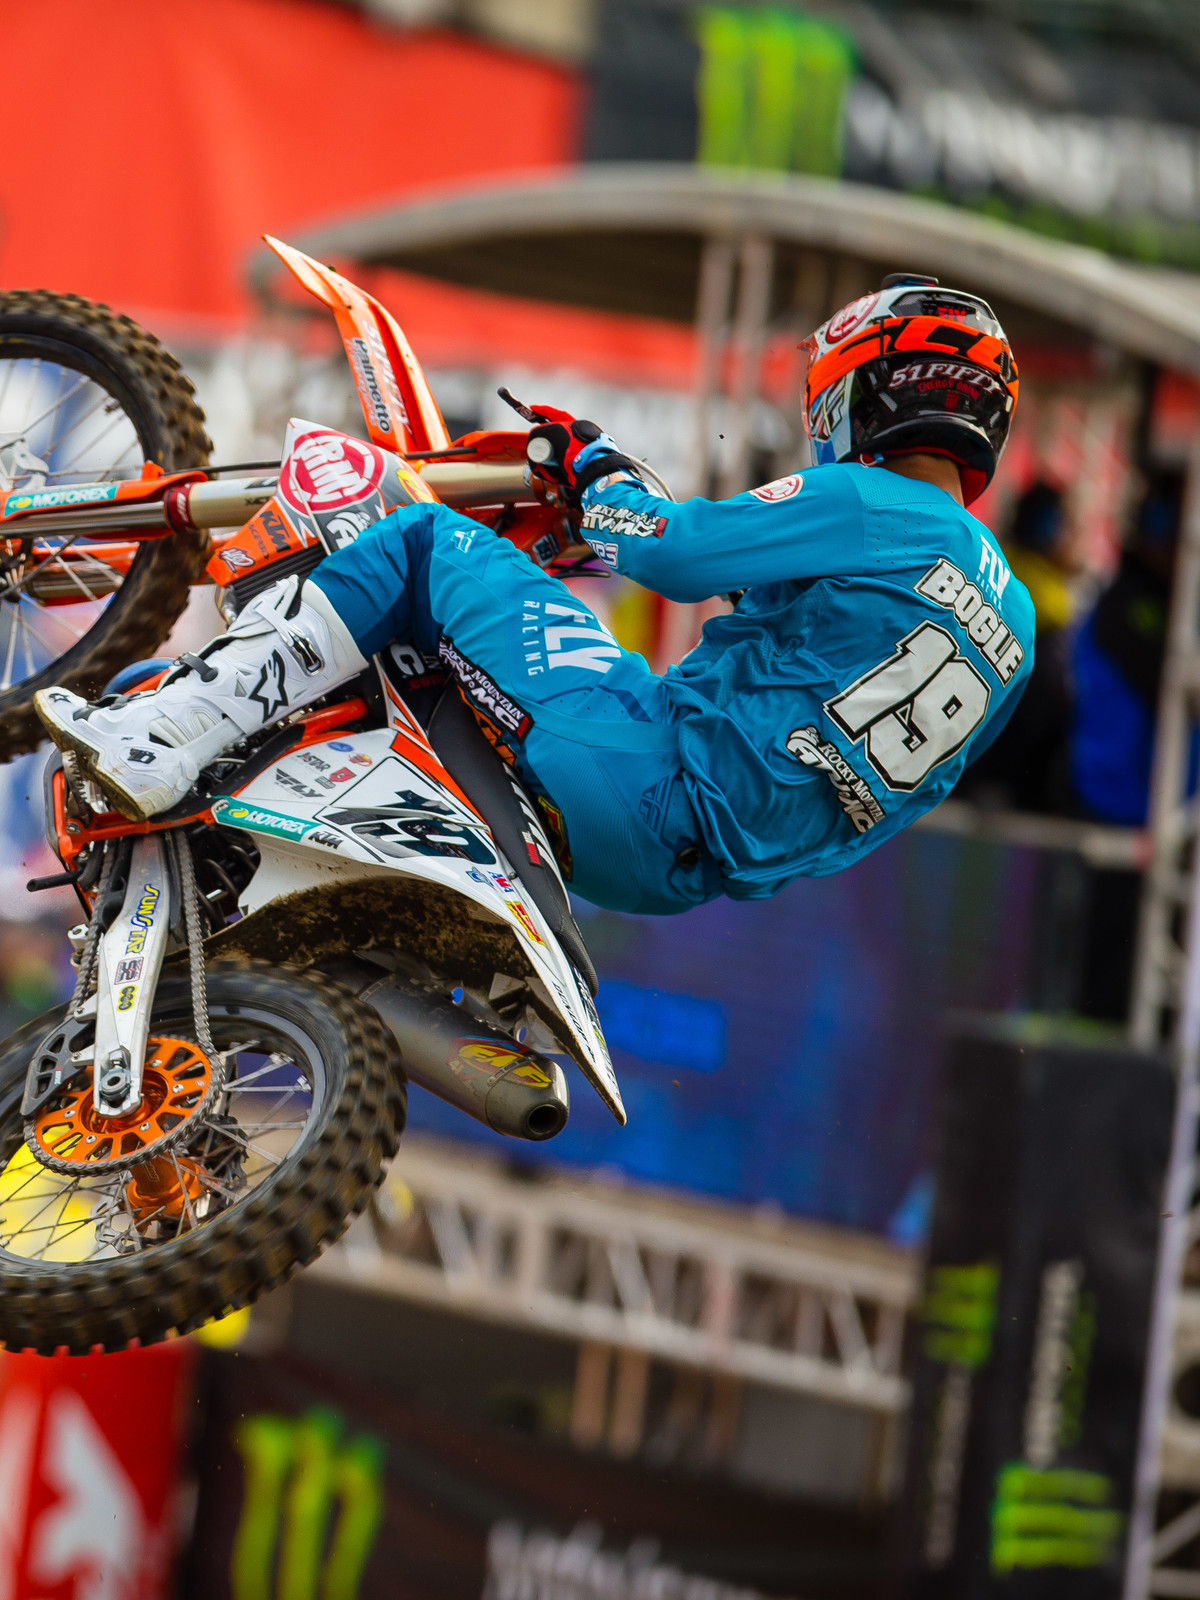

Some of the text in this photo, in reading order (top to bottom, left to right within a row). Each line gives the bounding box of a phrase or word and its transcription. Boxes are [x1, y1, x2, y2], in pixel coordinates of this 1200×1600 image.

[353, 336, 392, 433] Palmetto
[889, 363, 1003, 395] 51FIFTY
[918, 379, 954, 393] ENERGY
[32, 485, 110, 508] MOTOREX
[259, 510, 291, 552] KTM
[976, 572, 1002, 611] RACING
[979, 534, 1010, 599] FLY
[522, 600, 544, 676] RACING
[544, 602, 621, 674] FLY
[913, 558, 1024, 688] BOGLE
[472, 667, 525, 720] MOUNTAIN
[822, 619, 991, 792] 19
[820, 743, 857, 782] ROCKY
[245, 811, 311, 834] MOTOREX
[308, 831, 344, 850] KTM
[322, 789, 497, 865] 19
[552, 980, 588, 1044] DUNLOP
